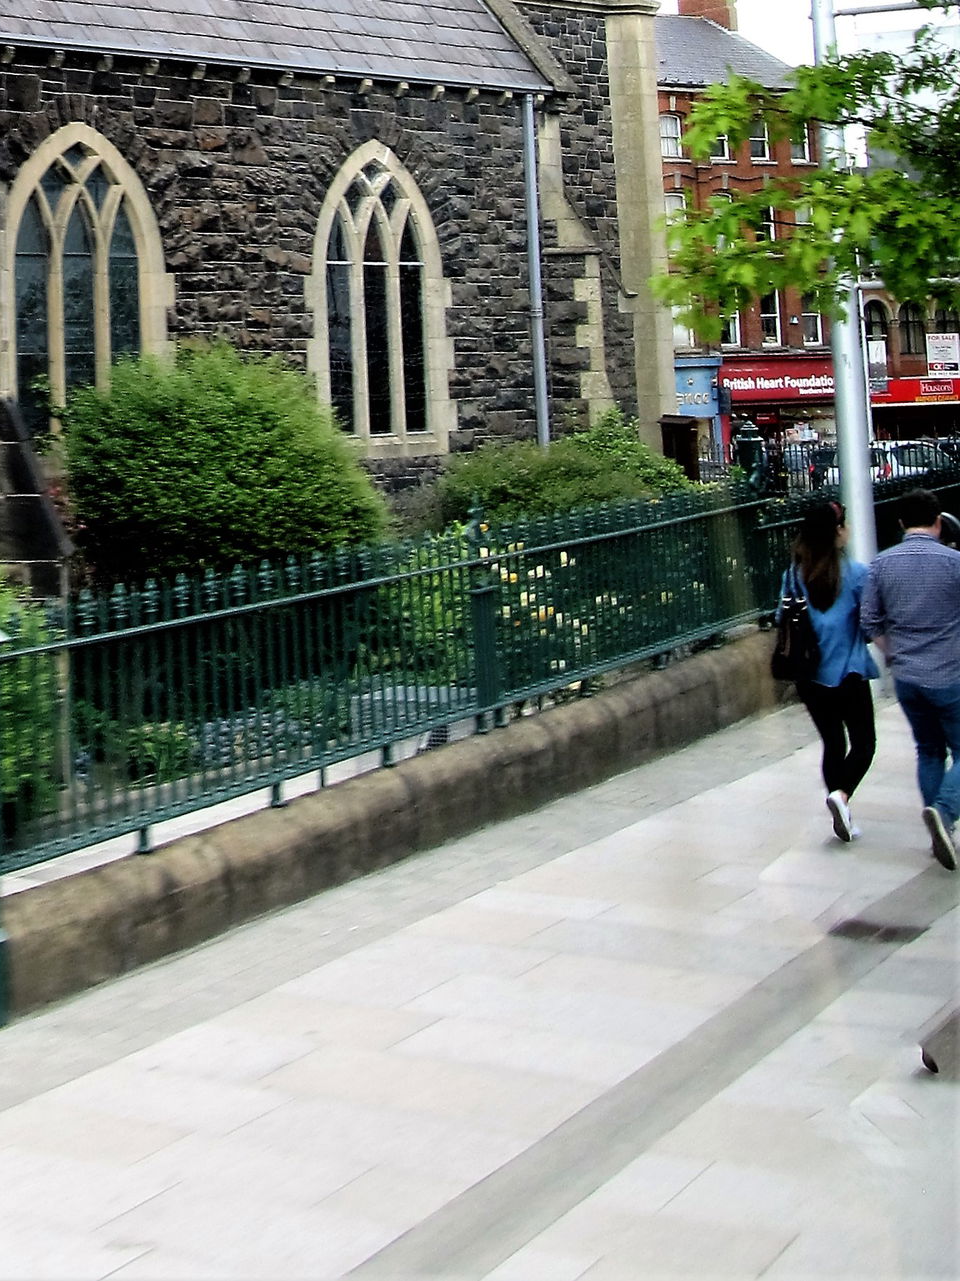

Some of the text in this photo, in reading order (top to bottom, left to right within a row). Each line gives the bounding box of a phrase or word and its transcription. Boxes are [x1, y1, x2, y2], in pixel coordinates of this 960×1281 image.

[723, 374, 834, 390] British Heart Foundatio
